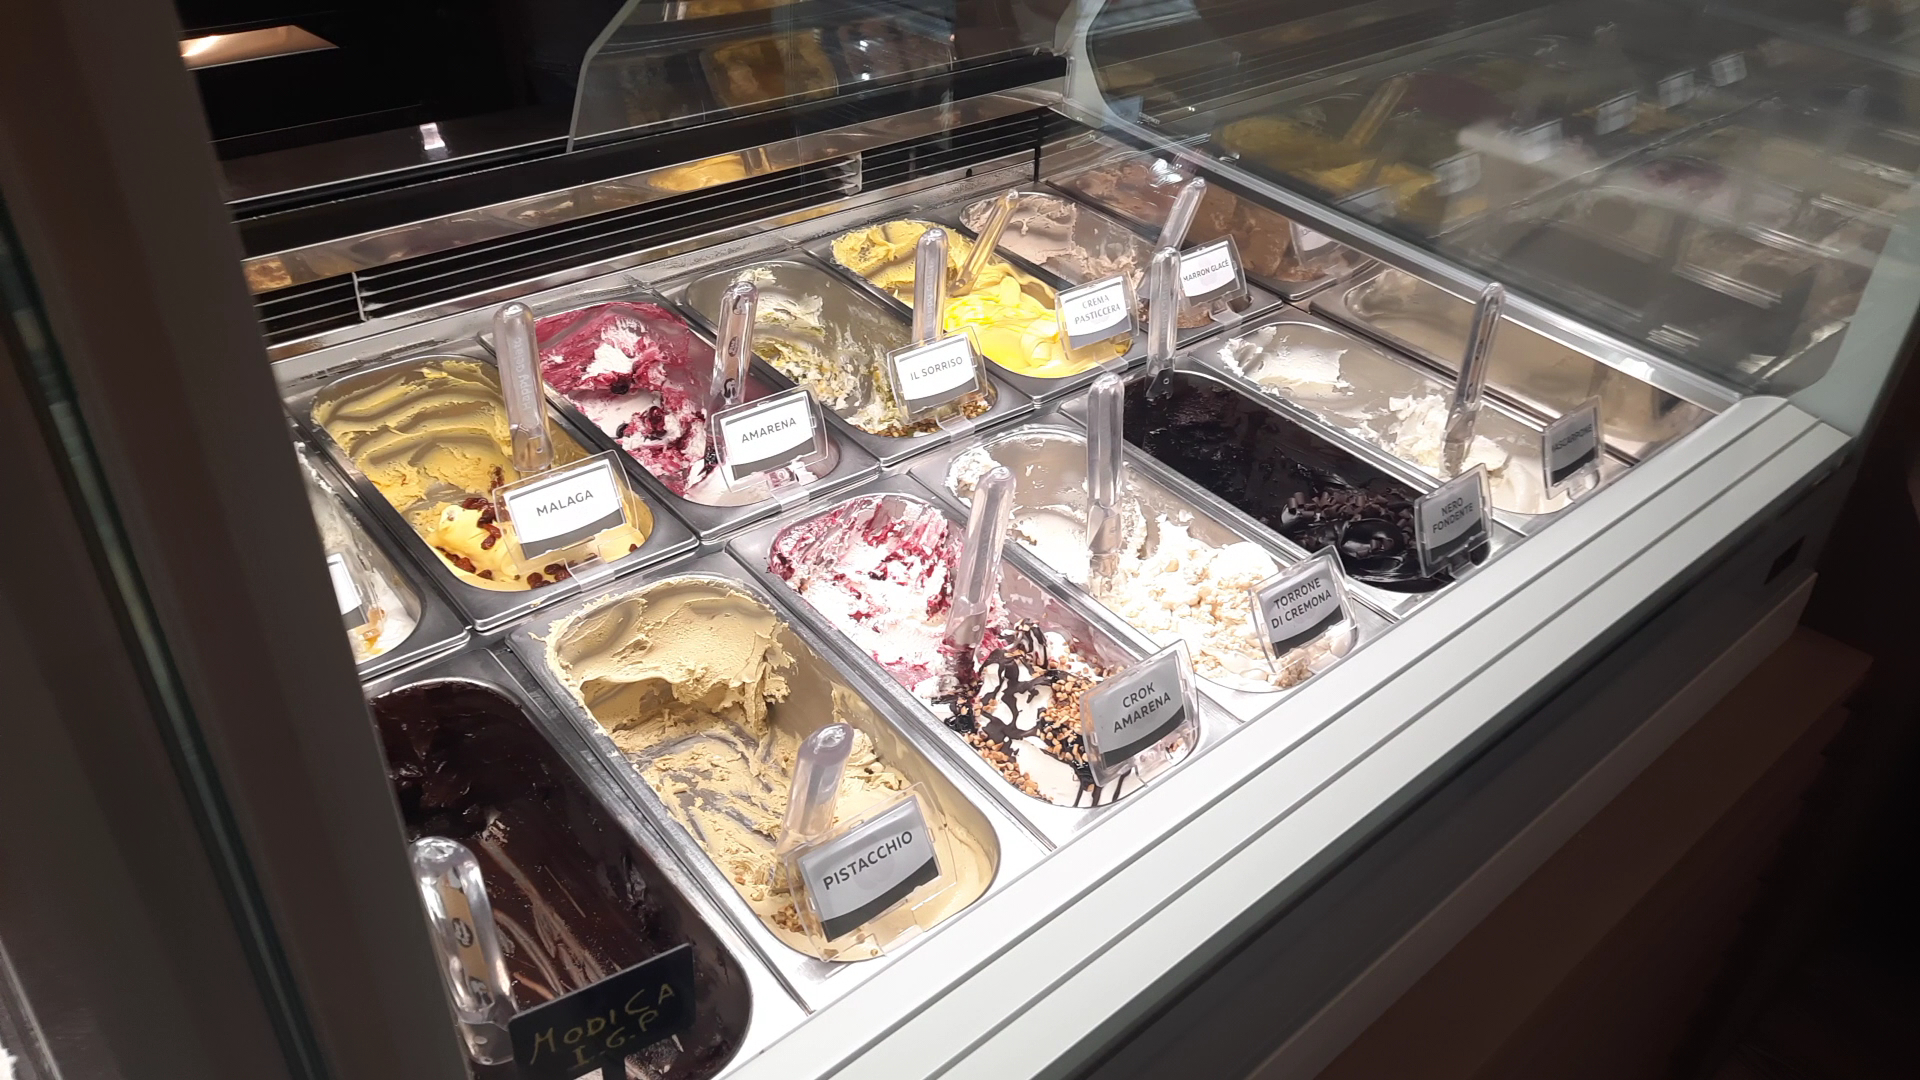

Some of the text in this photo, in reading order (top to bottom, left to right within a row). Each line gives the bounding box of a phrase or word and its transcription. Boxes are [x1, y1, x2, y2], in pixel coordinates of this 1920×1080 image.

[1183, 265, 1210, 282] MARRON
[1074, 303, 1121, 326] PASTICCERA
[1082, 294, 1110, 310] CREMA
[910, 355, 964, 382] IL SORRISO
[516, 373, 532, 411] Happy
[741, 417, 797, 443] AMARENA
[536, 489, 594, 517] MALAGA
[1441, 496, 1463, 517] NERO
[1432, 502, 1474, 534] FONDENTE
[1273, 577, 1322, 610] TORRONE
[1271, 590, 1333, 629] DI CREMONA
[1122, 682, 1156, 709] CROK
[1113, 693, 1171, 733] AMARENA
[823, 830, 914, 891] PISTACCHIO
[529, 983, 675, 1065] MODICA
